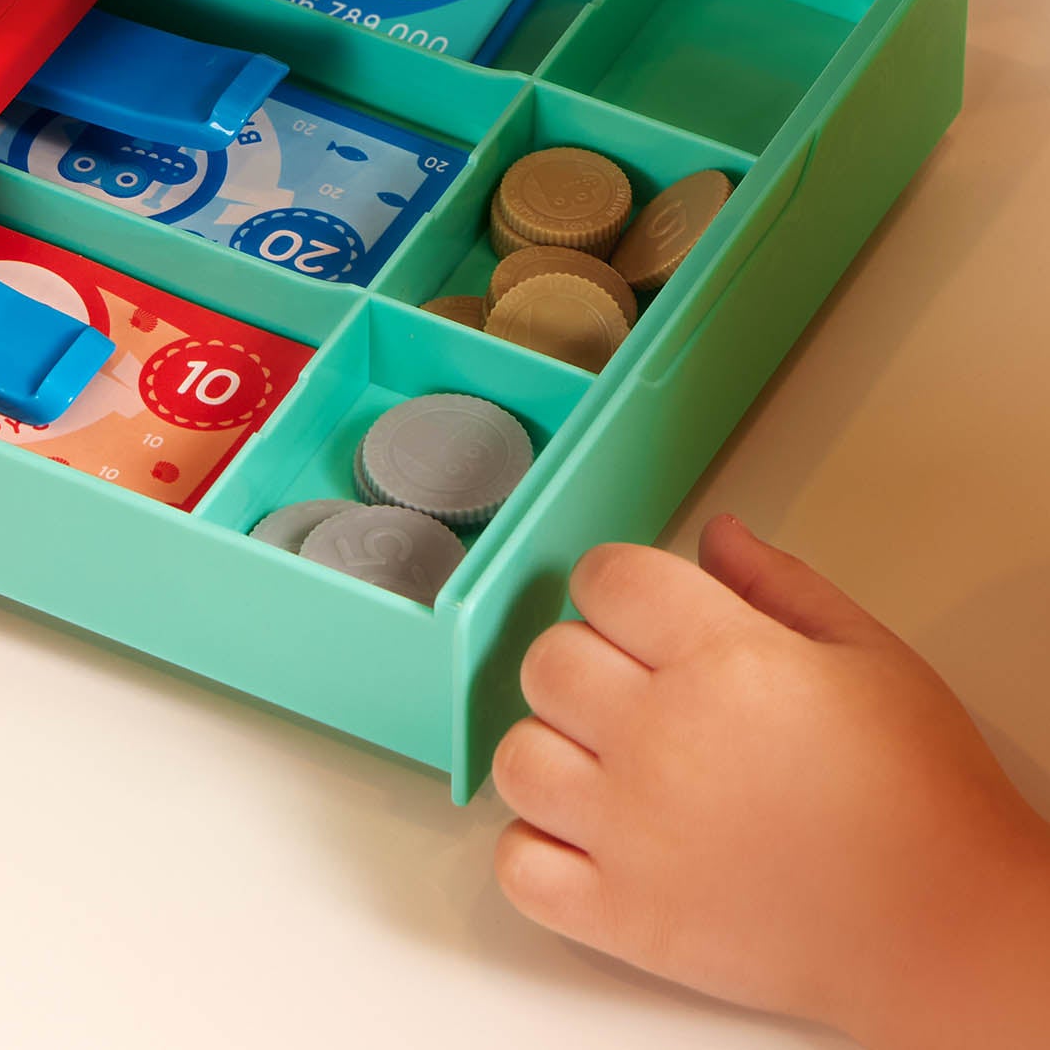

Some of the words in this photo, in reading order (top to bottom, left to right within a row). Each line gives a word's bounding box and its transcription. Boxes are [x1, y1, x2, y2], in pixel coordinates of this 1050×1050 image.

[292, 119, 319, 137] 20
[423, 156, 450, 173] 20
[318, 183, 345, 200] 20
[258, 229, 341, 273] 20
[176, 360, 241, 406] 10
[141, 432, 164, 449] 10
[98, 465, 120, 481] 10
